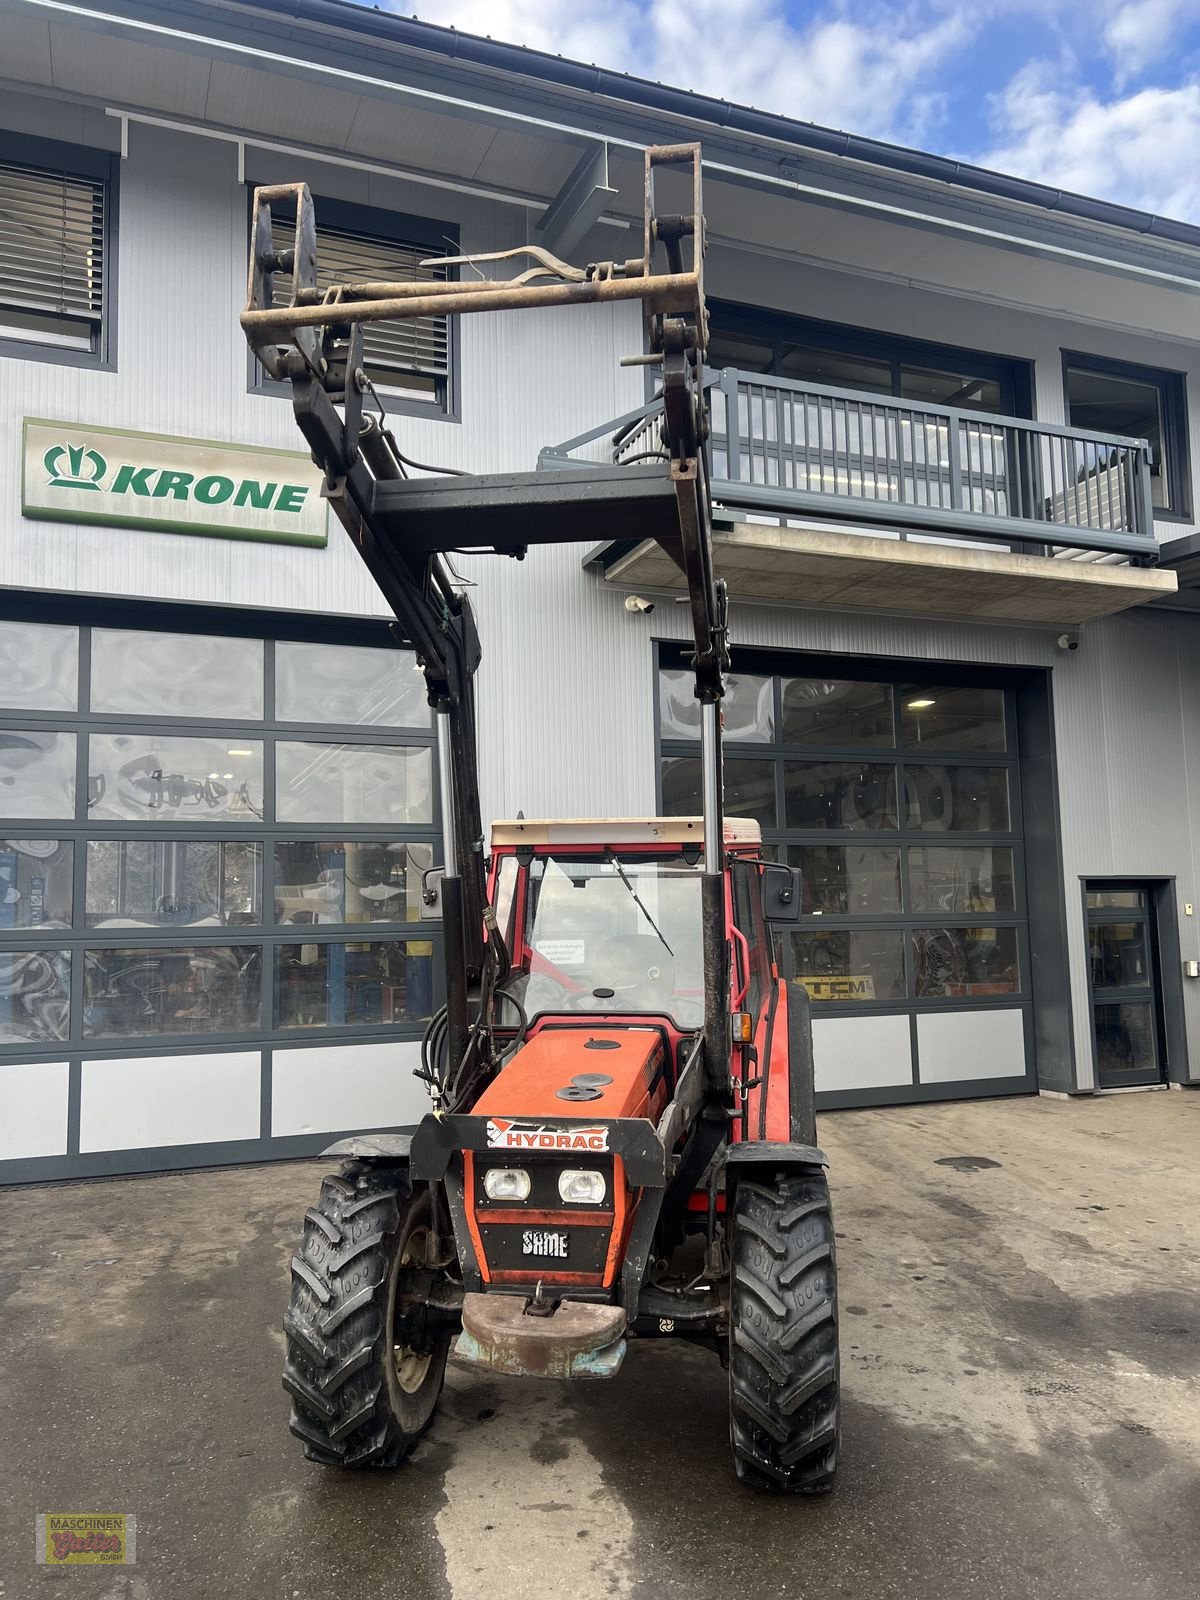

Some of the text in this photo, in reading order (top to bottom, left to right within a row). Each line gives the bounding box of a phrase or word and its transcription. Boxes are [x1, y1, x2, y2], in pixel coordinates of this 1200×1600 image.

[110, 465, 309, 513] KRONE
[506, 1133, 604, 1149] HYDRAC
[522, 1231, 568, 1258] SAME
